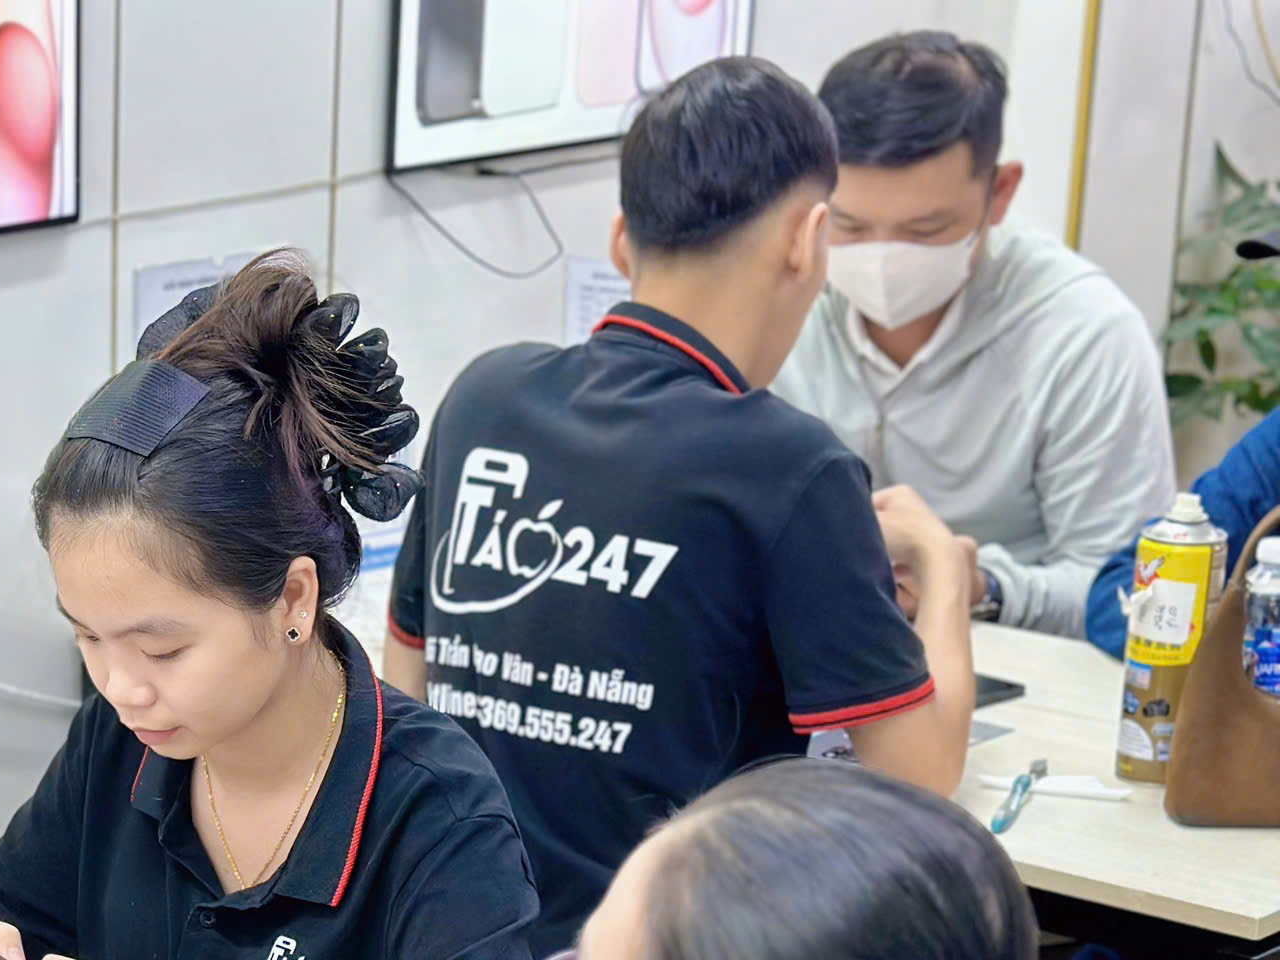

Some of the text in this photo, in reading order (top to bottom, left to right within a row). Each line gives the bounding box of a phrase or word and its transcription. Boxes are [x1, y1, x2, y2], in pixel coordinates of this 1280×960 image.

[501, 651, 534, 686] Vân
[551, 663, 584, 696] Đà
[586, 668, 655, 711] Nẵng
